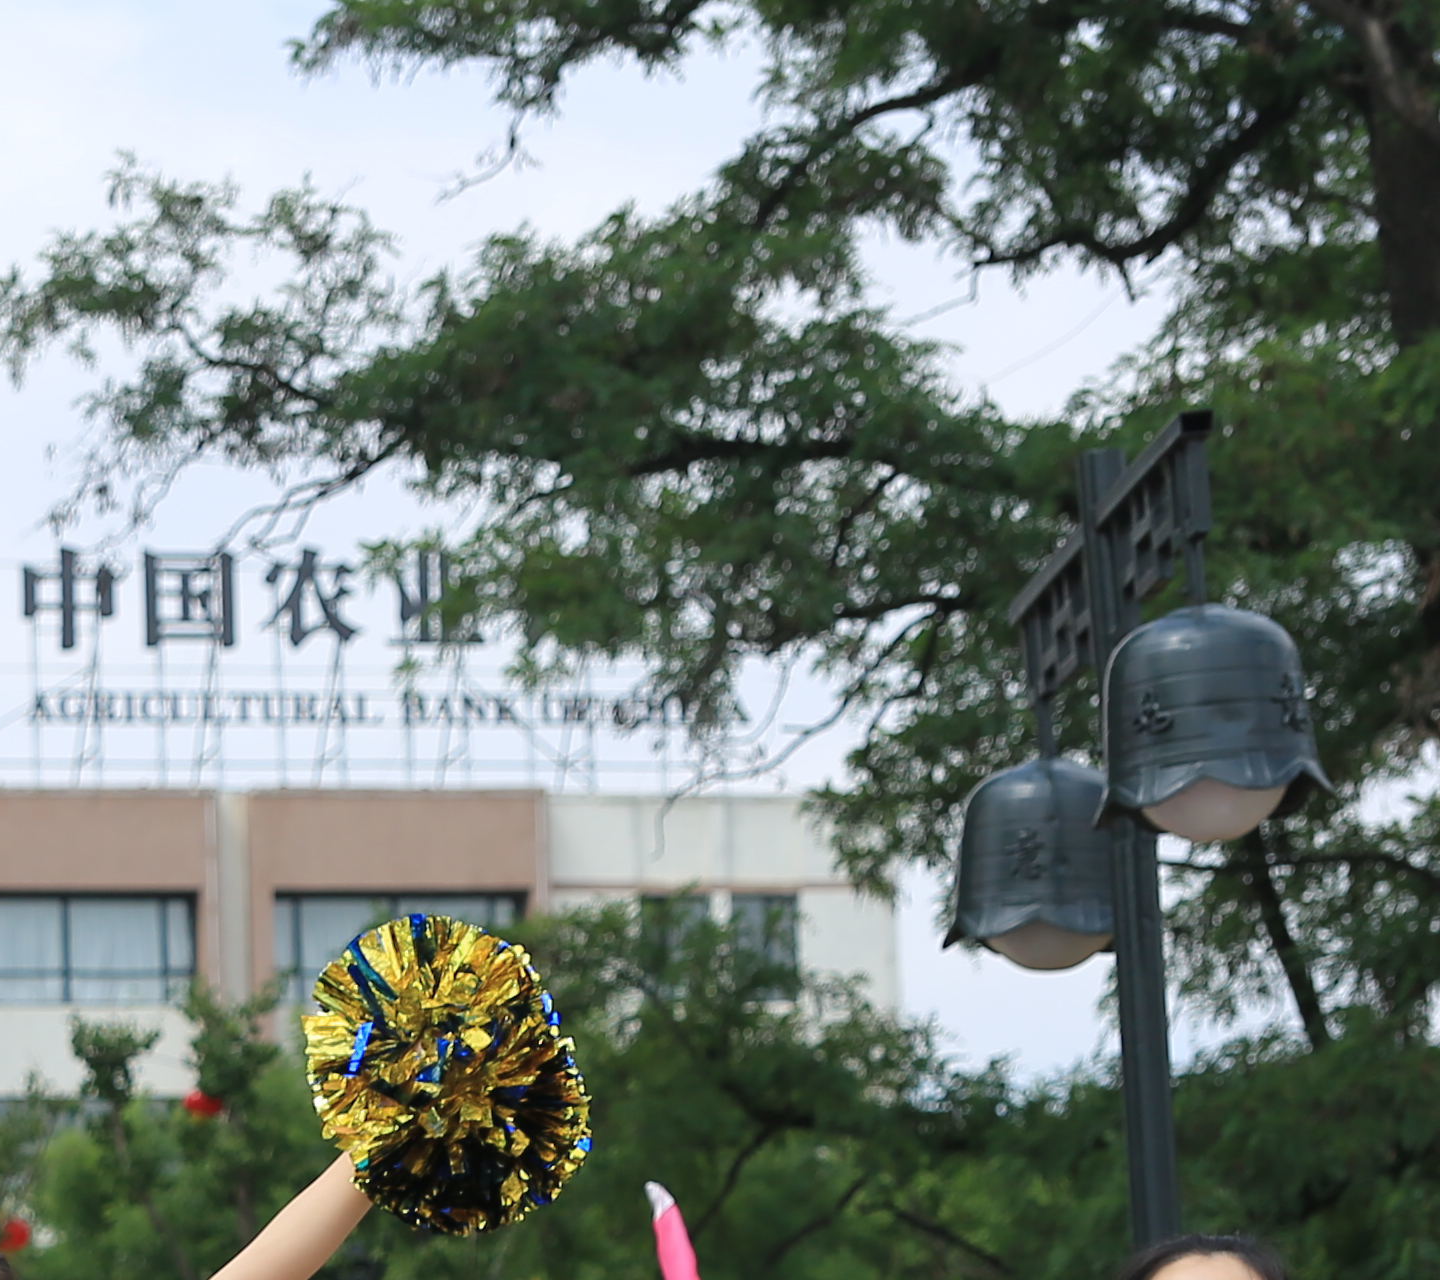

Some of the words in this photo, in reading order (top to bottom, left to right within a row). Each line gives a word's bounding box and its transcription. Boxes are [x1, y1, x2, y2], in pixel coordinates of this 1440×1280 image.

[24, 548, 485, 649] 中国农业
[32, 692, 382, 723] AGRICULTURAL
